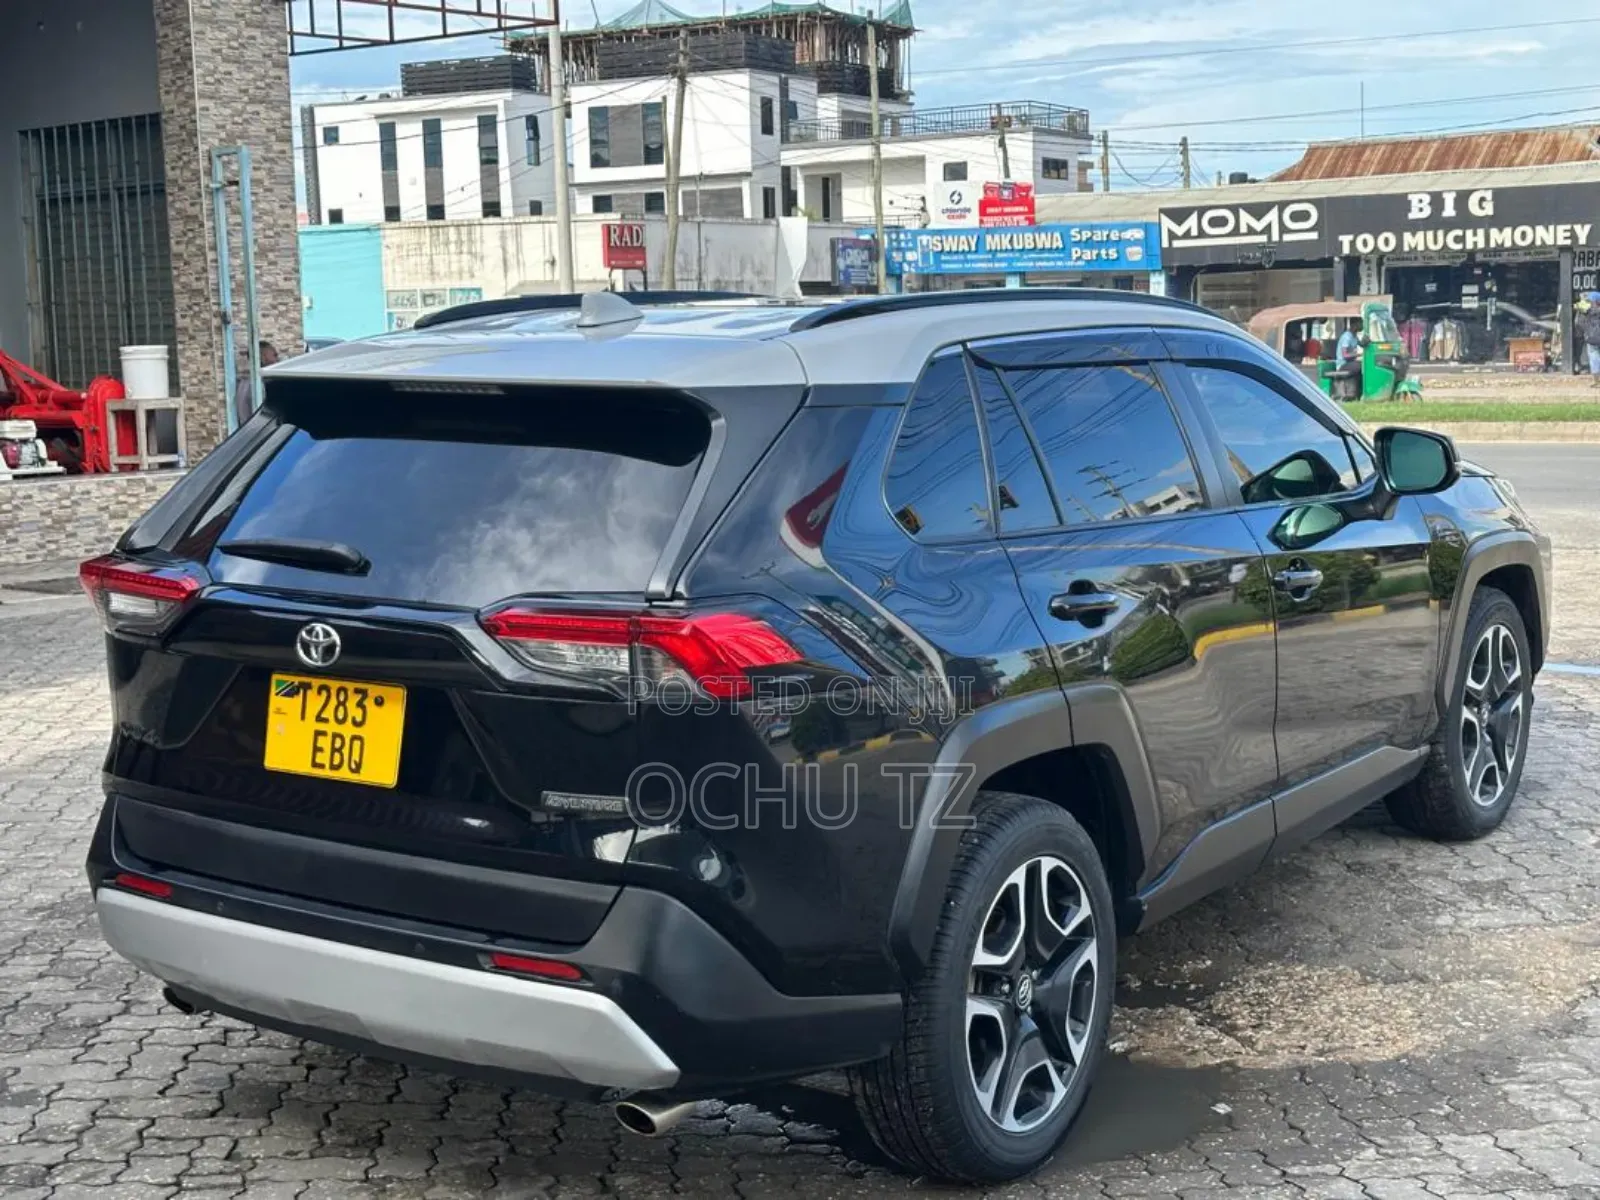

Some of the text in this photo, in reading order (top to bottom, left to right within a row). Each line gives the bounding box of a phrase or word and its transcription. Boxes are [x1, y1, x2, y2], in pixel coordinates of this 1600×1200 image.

[1408, 189, 1495, 220] BIG
[932, 228, 1121, 253] SWAY MKUBWA Spare
[1160, 202, 1319, 248] MOMO
[1338, 224, 1592, 255] TOO MUCH MONEY
[1071, 246, 1118, 262] Parts
[299, 681, 369, 728] T283
[311, 729, 365, 774] EBQ
